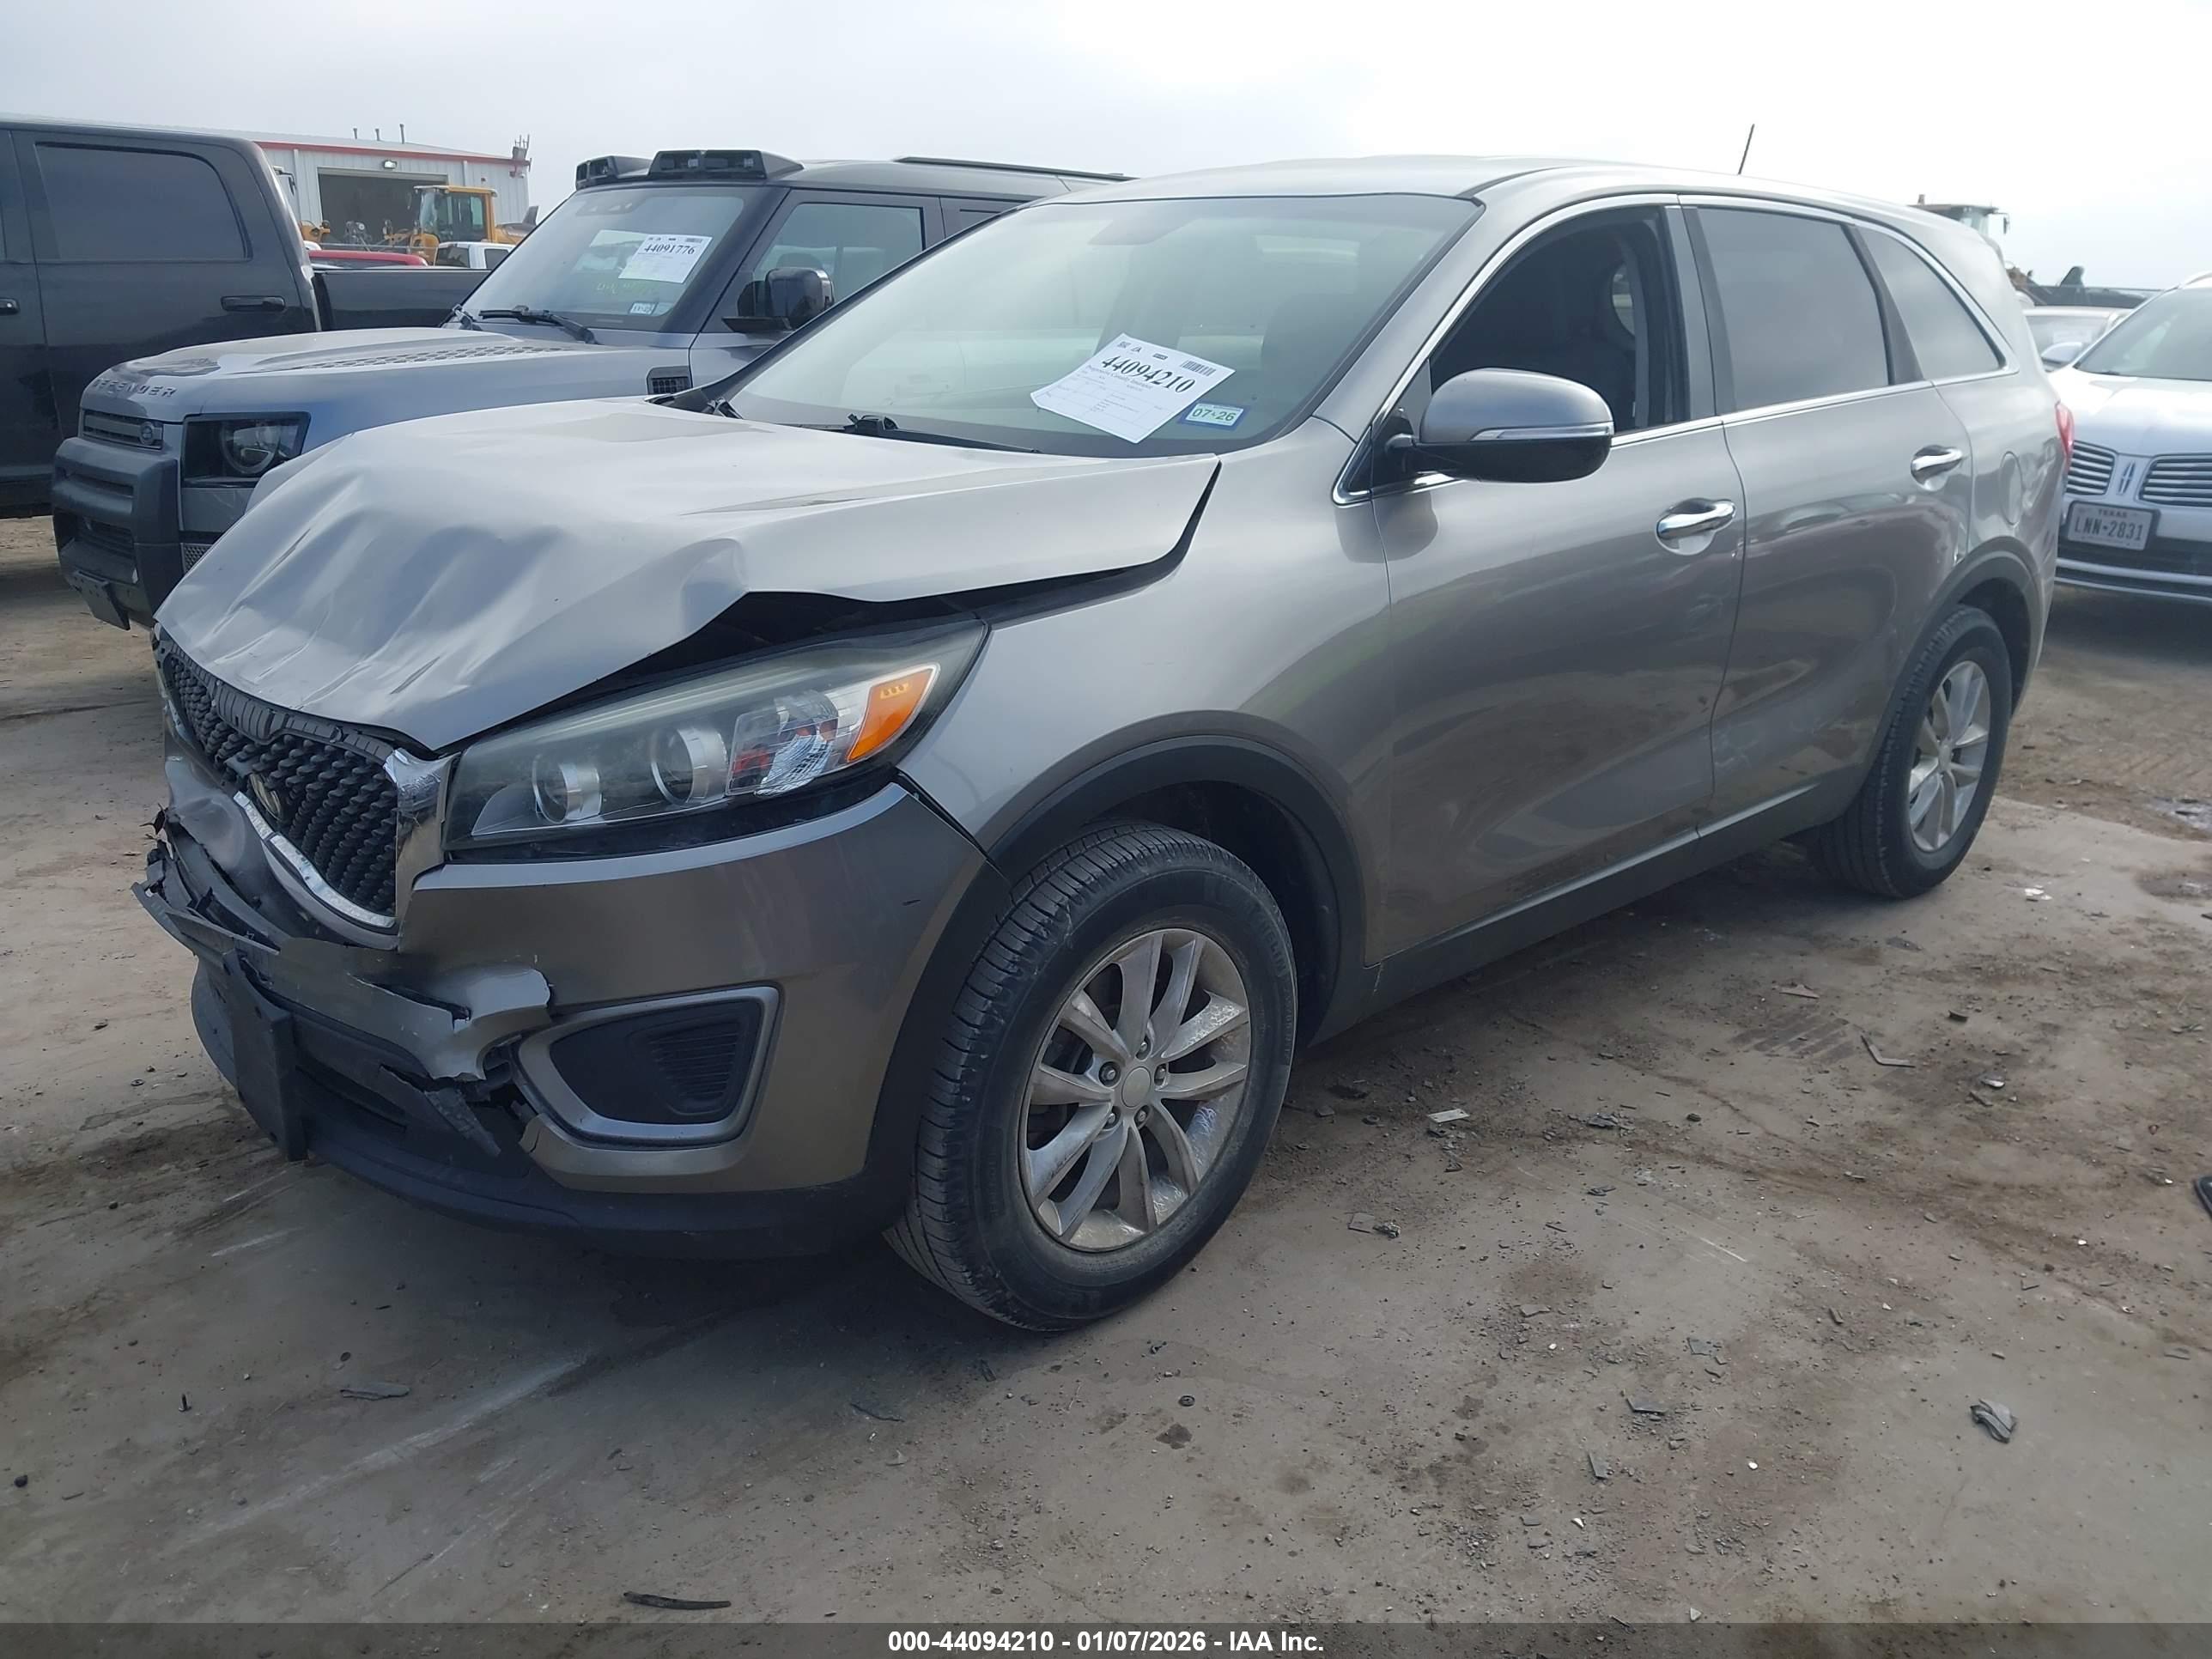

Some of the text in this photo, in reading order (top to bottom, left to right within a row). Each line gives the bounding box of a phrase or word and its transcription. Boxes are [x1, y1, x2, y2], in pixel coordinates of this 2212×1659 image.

[644, 244, 695, 255] 44091776
[1101, 356, 1196, 393] 44094210
[2098, 509, 2128, 519] TEXAS
